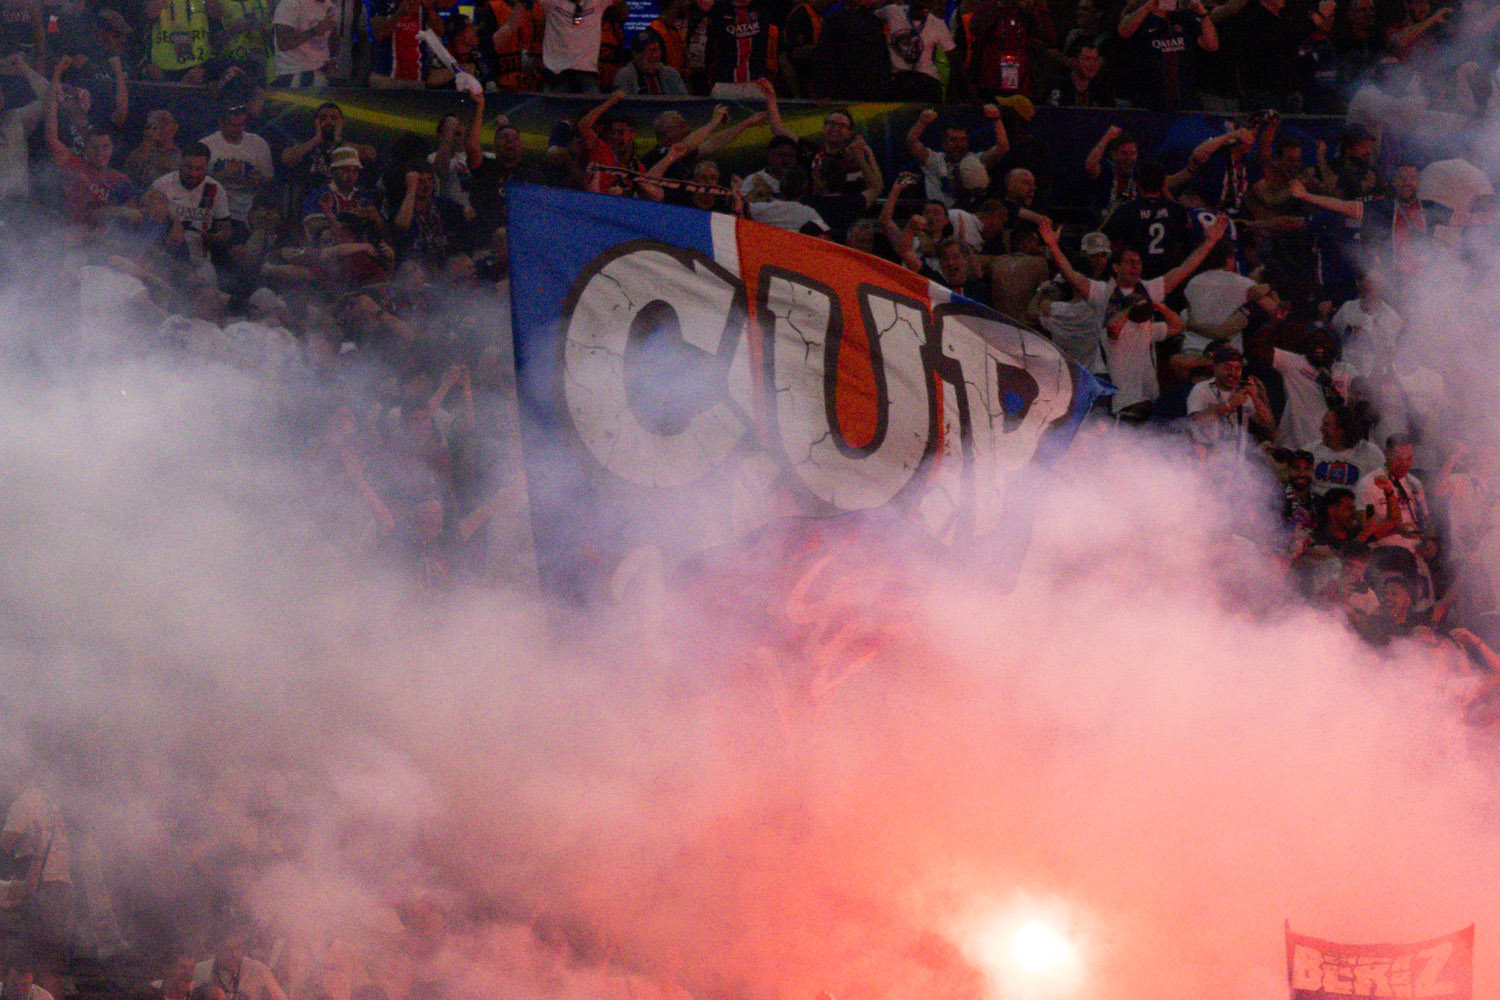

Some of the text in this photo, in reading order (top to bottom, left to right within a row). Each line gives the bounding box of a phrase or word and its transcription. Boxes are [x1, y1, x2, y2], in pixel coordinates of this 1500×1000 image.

[1151, 37, 1185, 49] QATAR
[1148, 222, 1165, 255] 2
[560, 238, 1083, 545] CUP
